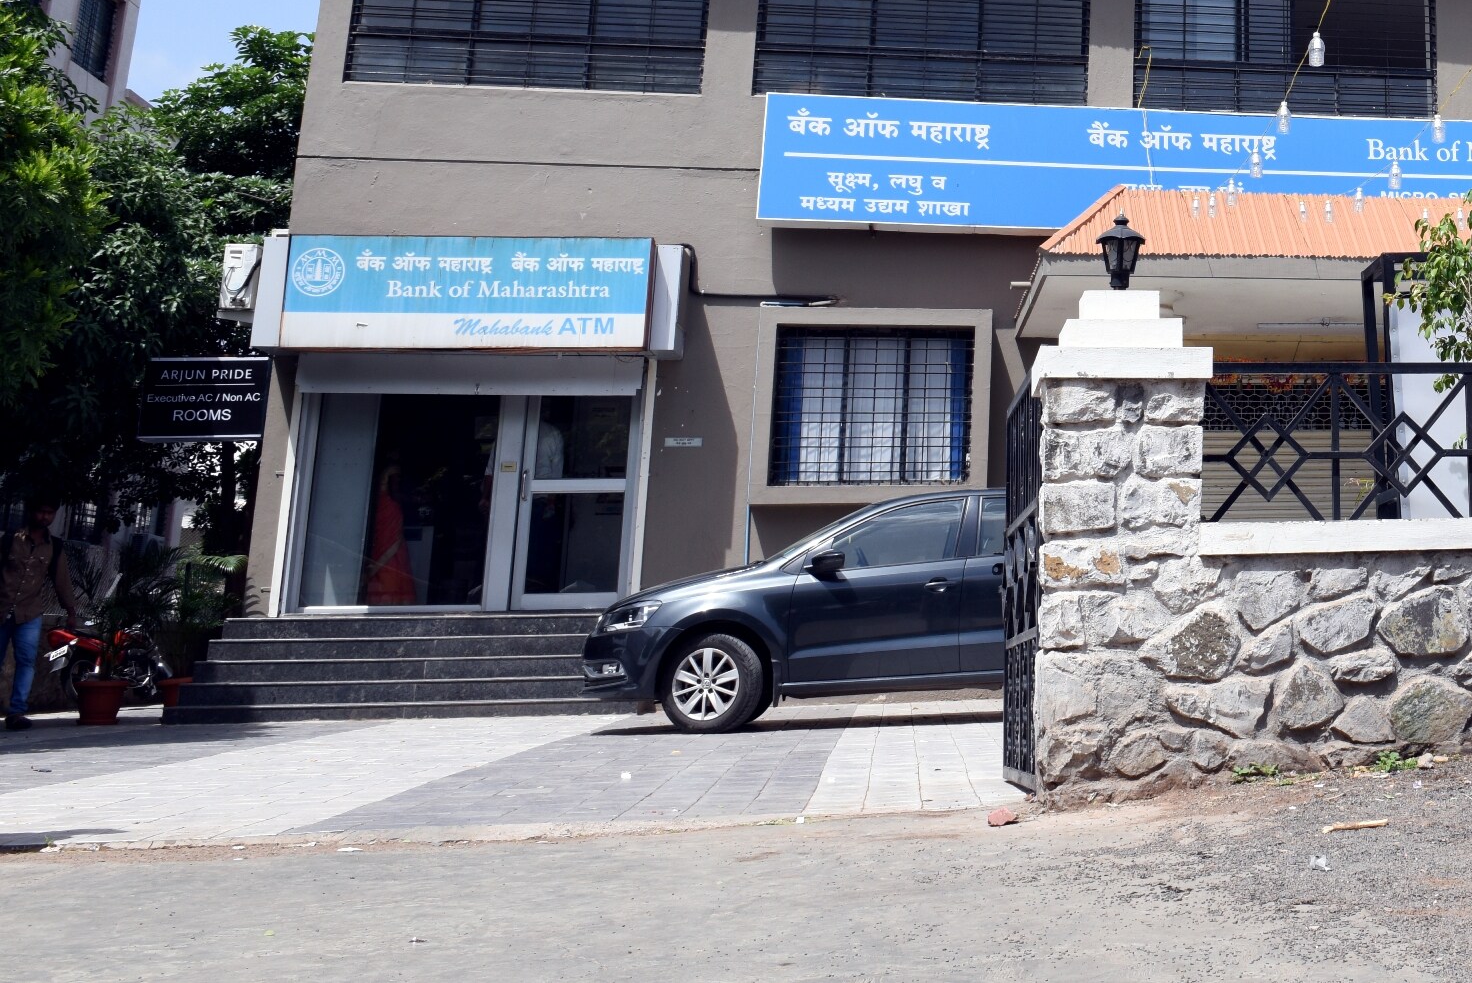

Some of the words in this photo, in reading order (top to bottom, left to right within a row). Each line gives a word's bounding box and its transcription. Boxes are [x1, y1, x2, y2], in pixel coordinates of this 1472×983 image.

[843, 111, 900, 138] ऑफ
[909, 121, 990, 150] महाराष्ट्र
[1086, 121, 1129, 148] बैंक
[1140, 124, 1192, 150] ऑफ
[1200, 133, 1276, 160] महाराष्ट्र
[1366, 138, 1429, 161] Bank
[1436, 140, 1461, 162] of
[888, 174, 923, 195] लघु
[930, 176, 947, 190] व
[799, 196, 856, 212] मध्यम
[863, 198, 909, 214] उद्यम
[917, 200, 970, 216] शाखा
[392, 252, 432, 271] ऑफ
[437, 257, 493, 274] महाराष्ट्र
[511, 252, 540, 272] बैंक
[546, 253, 585, 272] ऑफ
[591, 257, 645, 274] महाराष्ट्र
[386, 280, 442, 298] Bank
[448, 280, 474, 298] of
[477, 280, 610, 298] Maharashtra
[453, 317, 554, 336] Mahabank
[557, 317, 615, 335] ATM
[160, 369, 206, 382] ARJUN
[211, 369, 252, 379] PRIDE
[147, 393, 196, 403] Executive
[197, 393, 213, 402] AC
[222, 393, 243, 402] Non
[244, 392, 261, 401] AC
[173, 409, 232, 421] ROOMS
